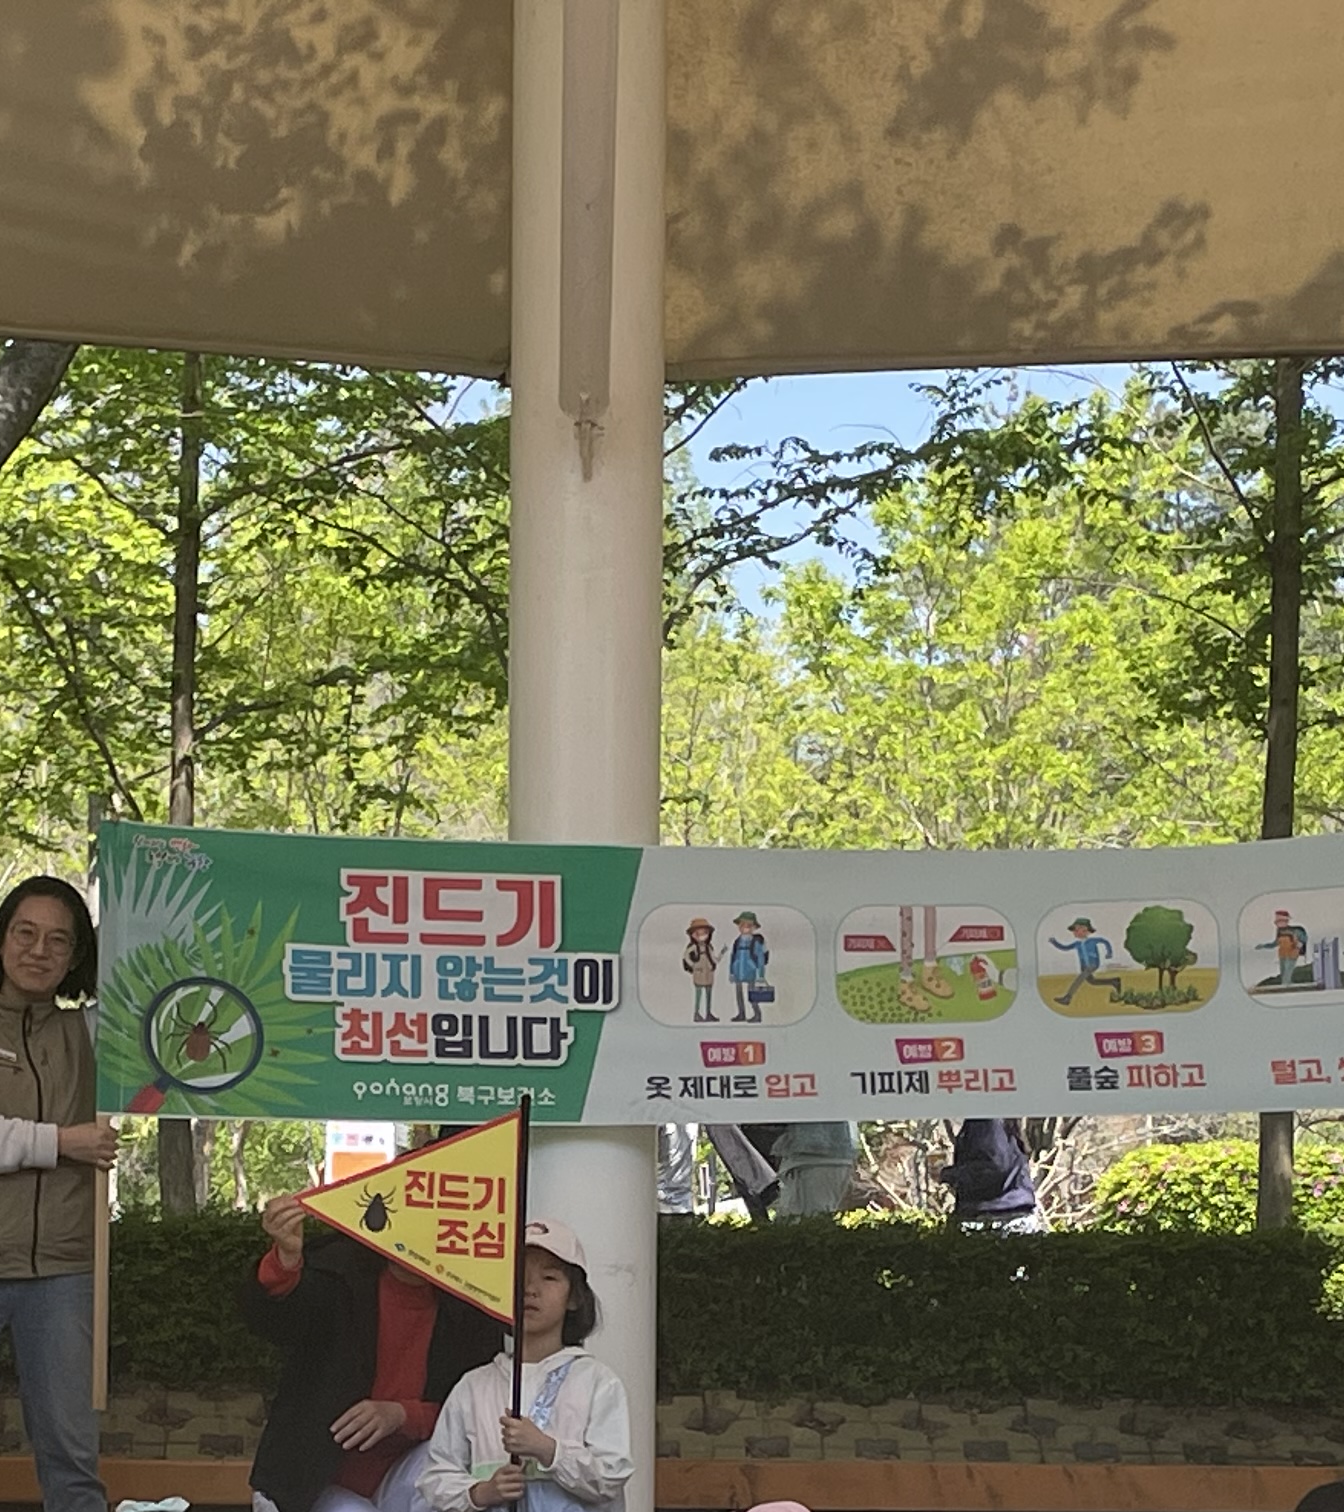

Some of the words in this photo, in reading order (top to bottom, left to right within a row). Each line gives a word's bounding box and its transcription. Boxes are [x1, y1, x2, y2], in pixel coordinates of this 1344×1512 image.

[346, 875, 555, 948] 진드기
[290, 948, 421, 998] 물리지
[435, 954, 613, 1004] 않는것이
[341, 1008, 567, 1060] 최선입니다
[1140, 1034, 1156, 1051] 3
[743, 1045, 755, 1062] 1
[941, 1041, 958, 1059] 2
[850, 1069, 930, 1096] 기피제
[936, 1068, 1017, 1093] 뿌리고
[1066, 1065, 1120, 1091] 풀숲
[1126, 1063, 1207, 1088] 피하고
[1270, 1059, 1332, 1085] 털고,
[645, 1076, 673, 1100] 옷
[678, 1074, 759, 1099] 제대로
[765, 1074, 818, 1098] 입고
[405, 1170, 505, 1214] 진드기
[435, 1218, 505, 1259] 조심
